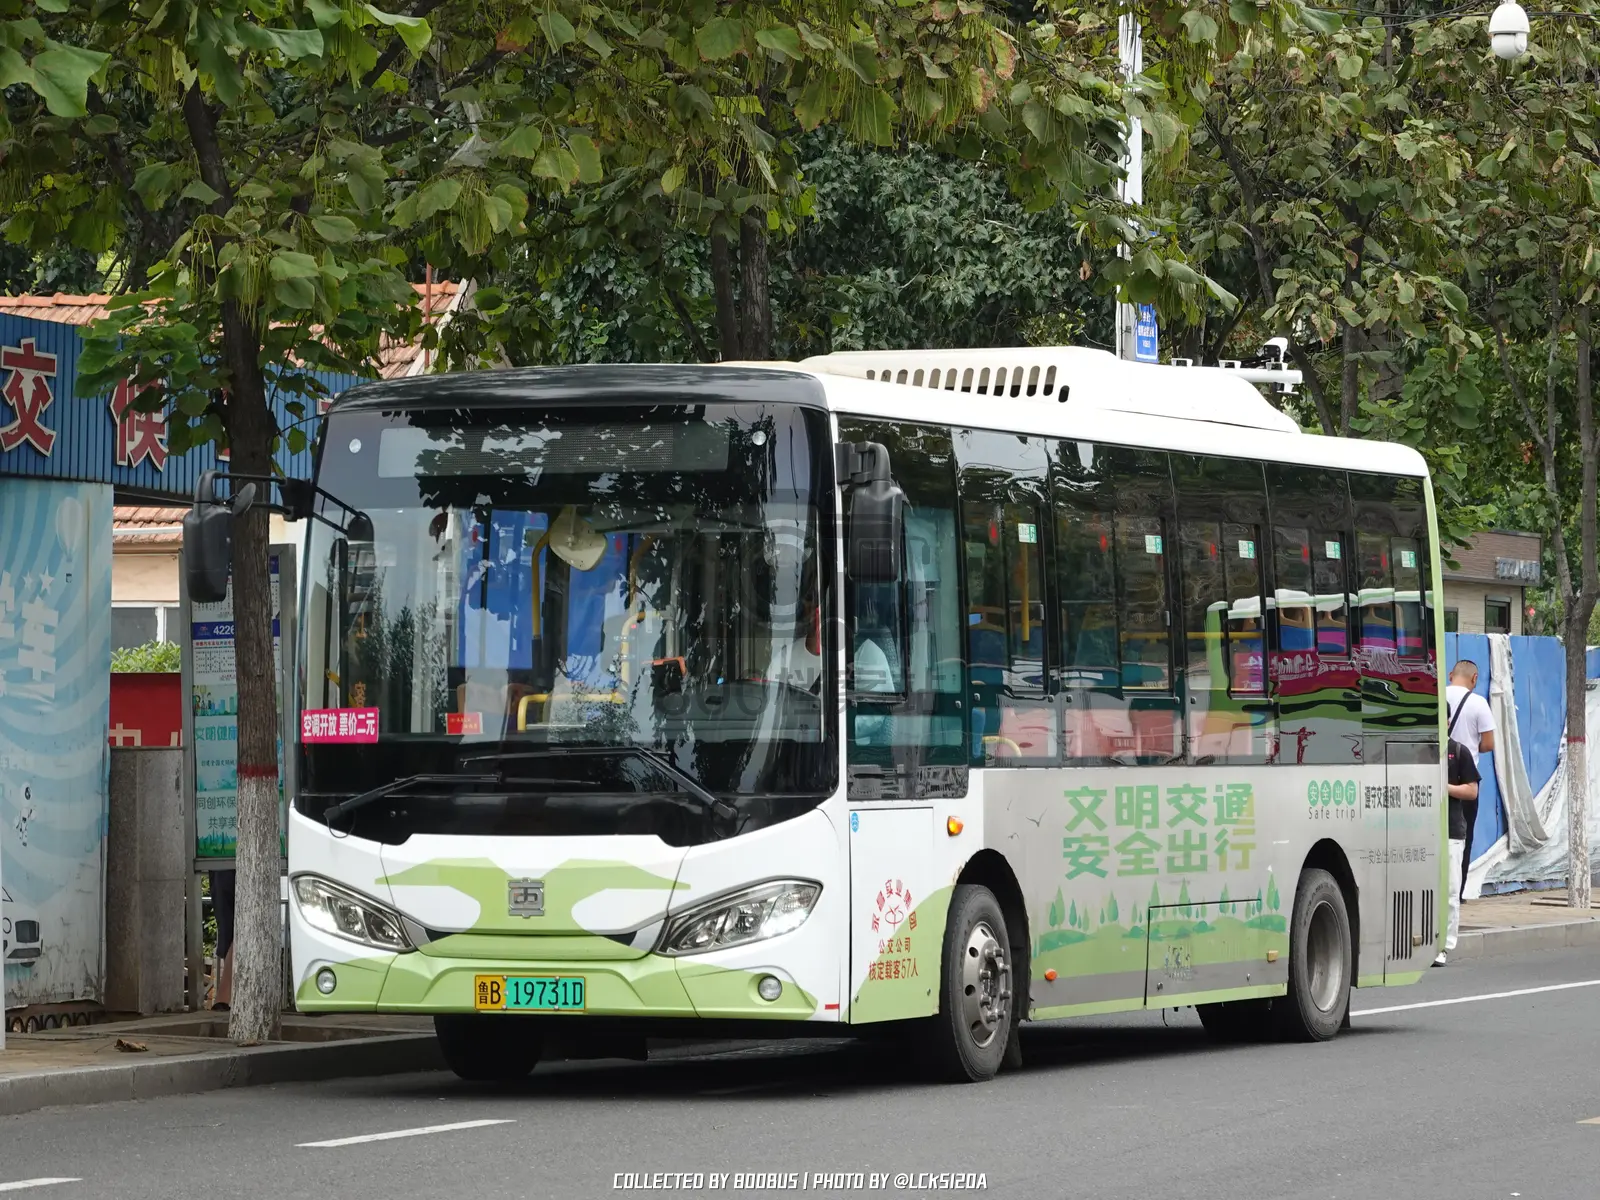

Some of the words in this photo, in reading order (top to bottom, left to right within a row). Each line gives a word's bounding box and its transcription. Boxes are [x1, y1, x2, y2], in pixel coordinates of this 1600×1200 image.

[303, 713, 337, 737] 空调开放
[339, 711, 376, 737] 票价二元
[1308, 781, 1356, 804] 安全出行
[1063, 782, 1256, 833] 文明交通
[1308, 805, 1330, 820] Safe
[1335, 805, 1356, 822] trip
[1062, 829, 1257, 880] 安全出行
[878, 937, 911, 955] 公交公司
[868, 957, 919, 981] 核定载客57人
[477, 980, 502, 1006] 鲁B
[512, 980, 584, 1007] 19731D
